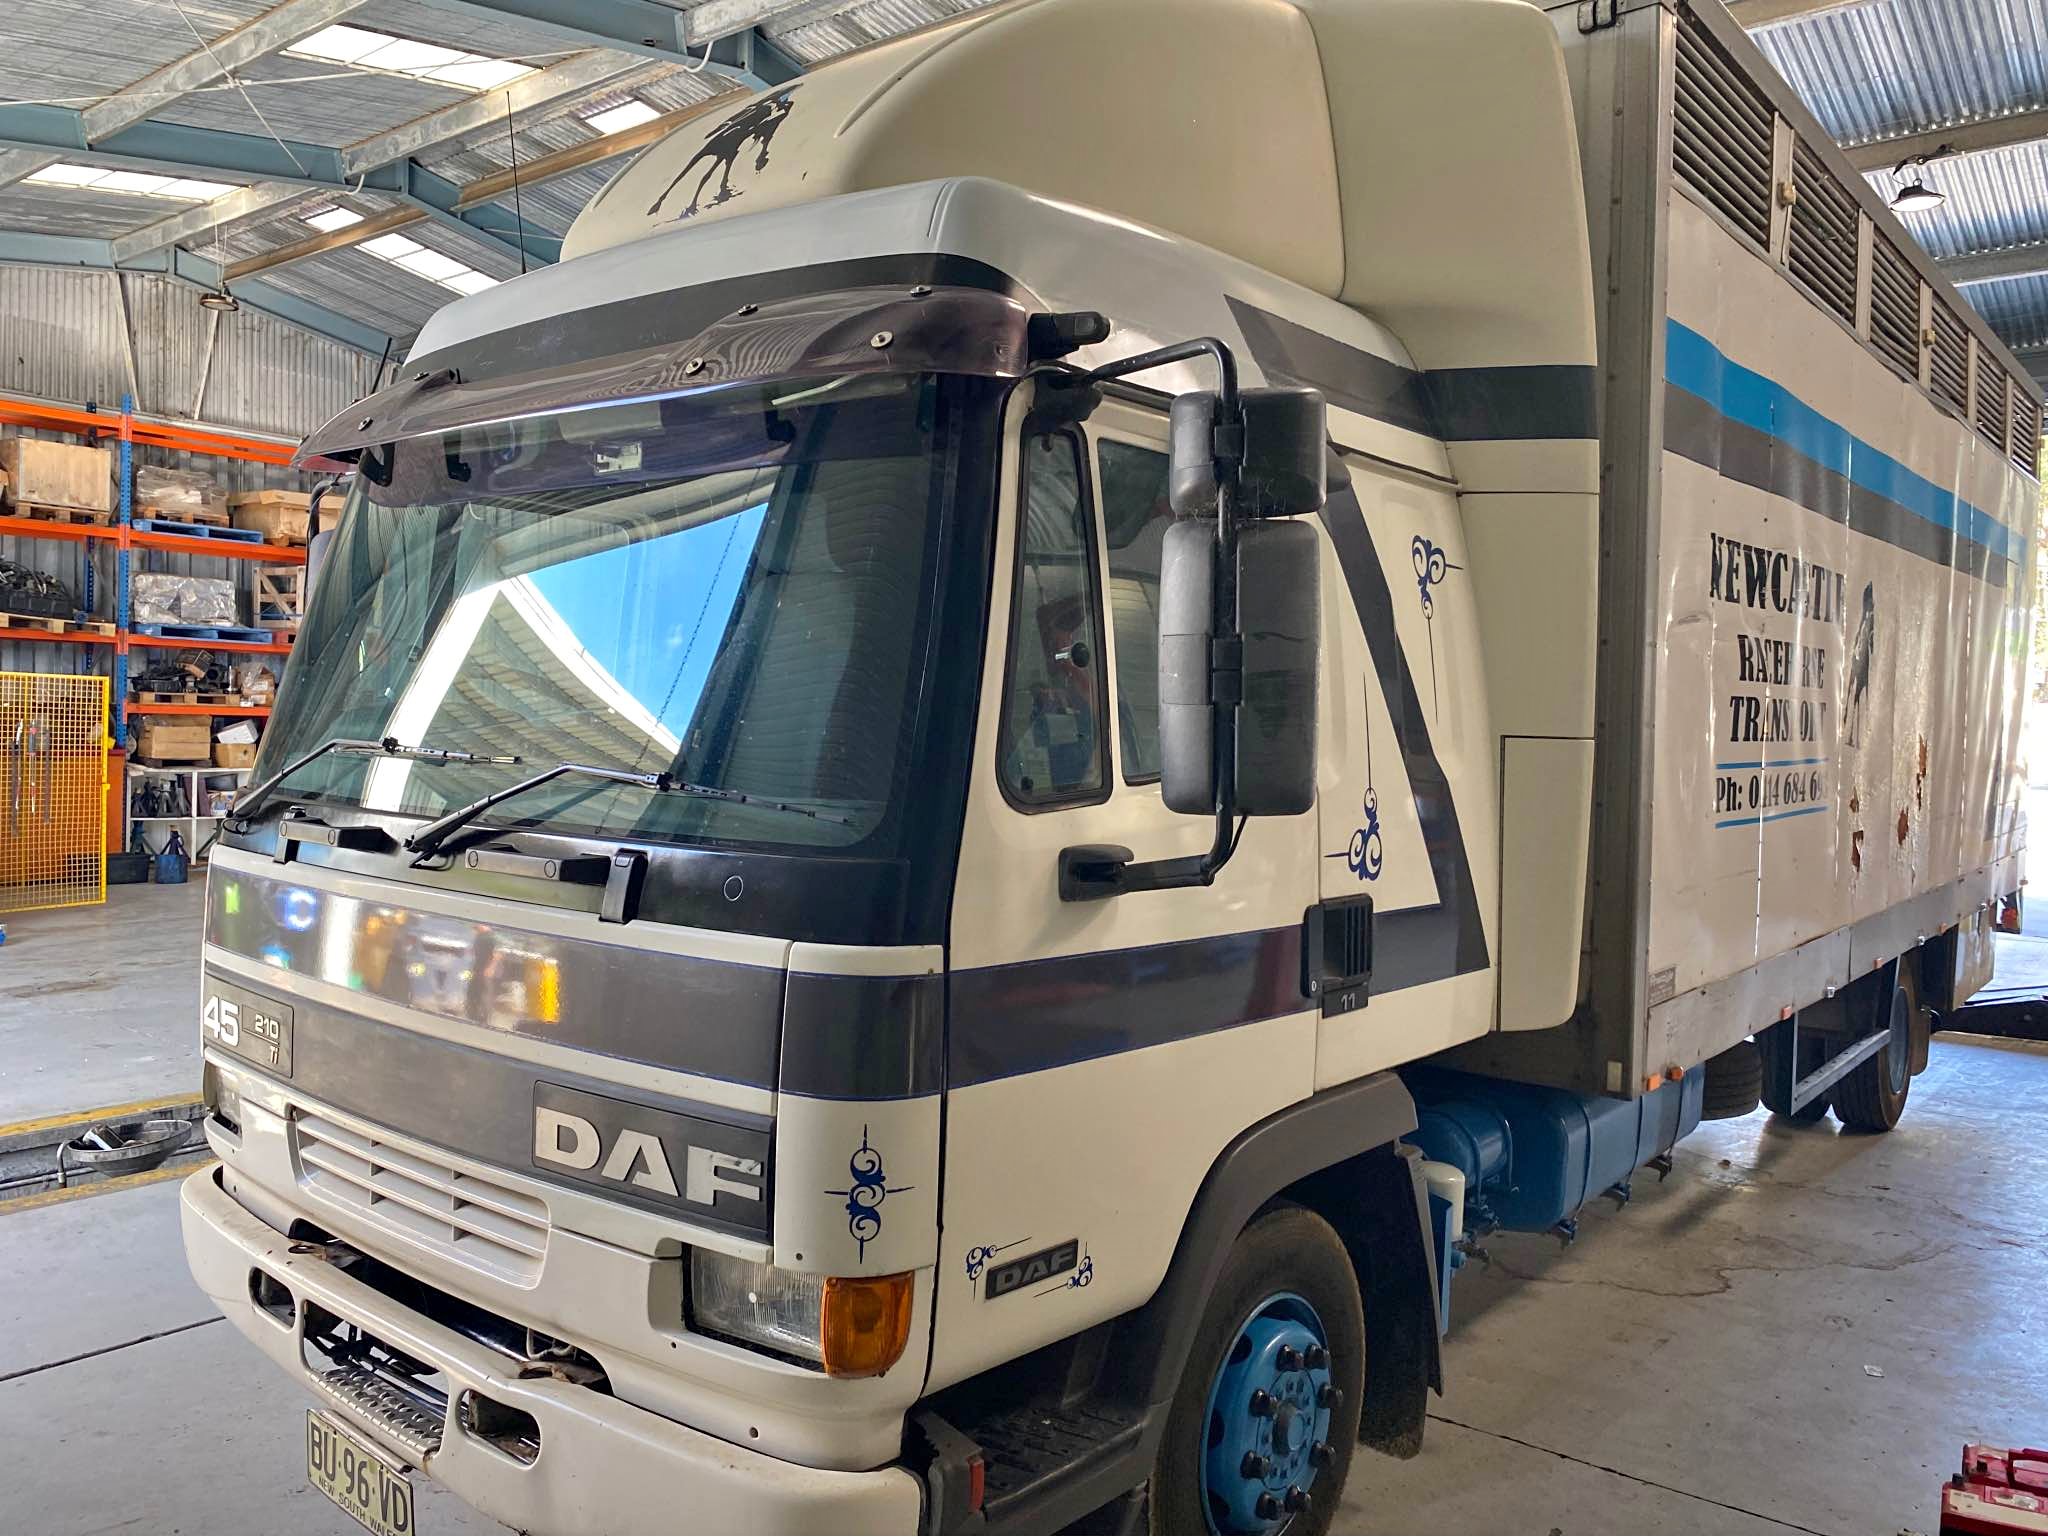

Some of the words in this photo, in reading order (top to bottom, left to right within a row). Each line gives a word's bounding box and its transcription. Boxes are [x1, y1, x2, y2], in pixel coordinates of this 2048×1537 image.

[1710, 532, 1846, 623] NEWCATLE
[1715, 776, 1743, 813] Ph:
[203, 995, 239, 1047] 45
[254, 1013, 281, 1040] 210
[269, 1045, 280, 1065] Ti
[535, 1105, 762, 1207] DAF
[996, 1250, 1074, 1293] DAF
[318, 1474, 335, 1497] NEW
[338, 1492, 367, 1522] SOUTH
[369, 1515, 398, 1536] WALE
